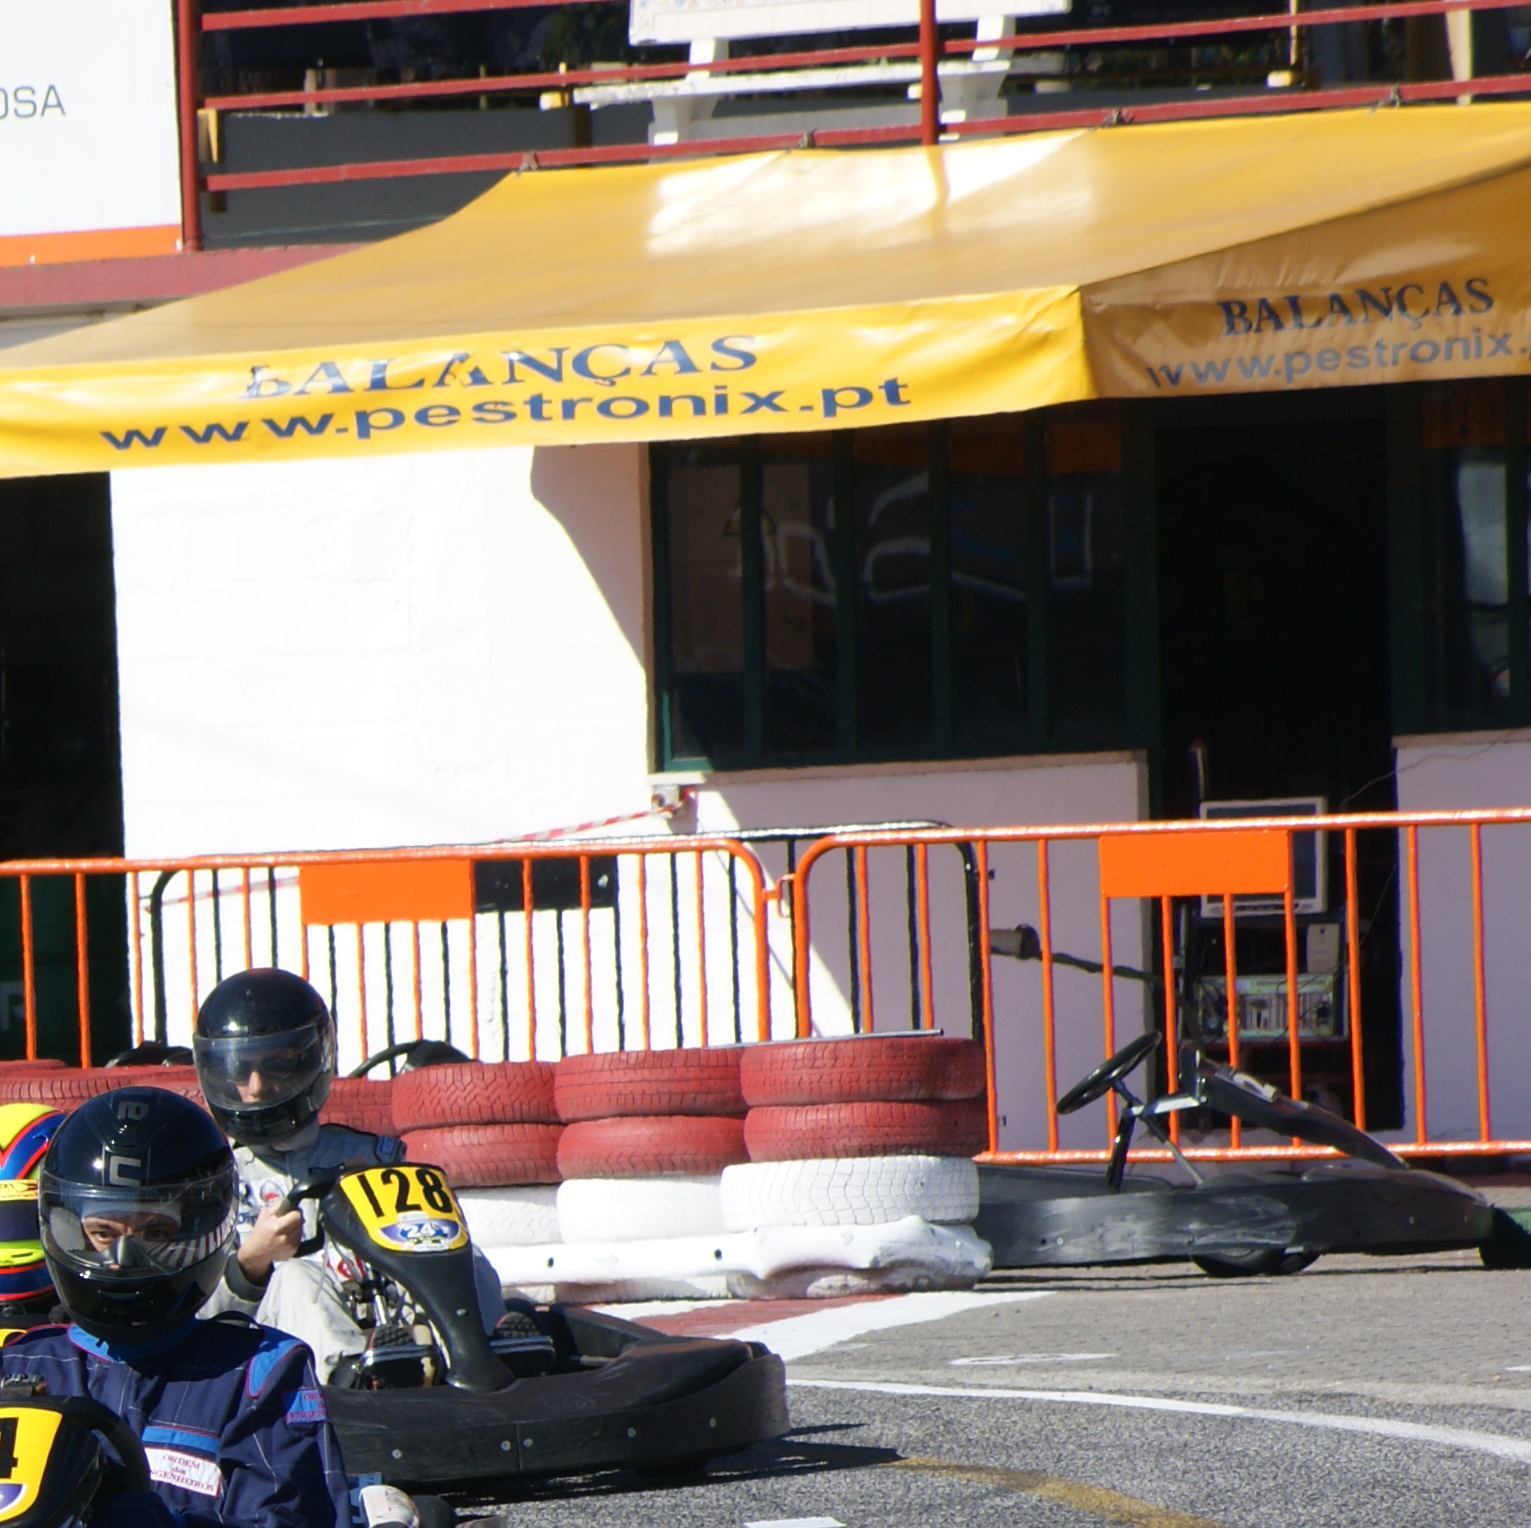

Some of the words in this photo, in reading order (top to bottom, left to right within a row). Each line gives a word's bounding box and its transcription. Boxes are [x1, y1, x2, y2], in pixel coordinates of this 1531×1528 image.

[1218, 277, 1495, 337] BALANÇAS
[98, 374, 914, 452] www.pestronix.pt
[356, 1168, 454, 1218] 128
[150, 1469, 215, 1492] NGENHEIROS
